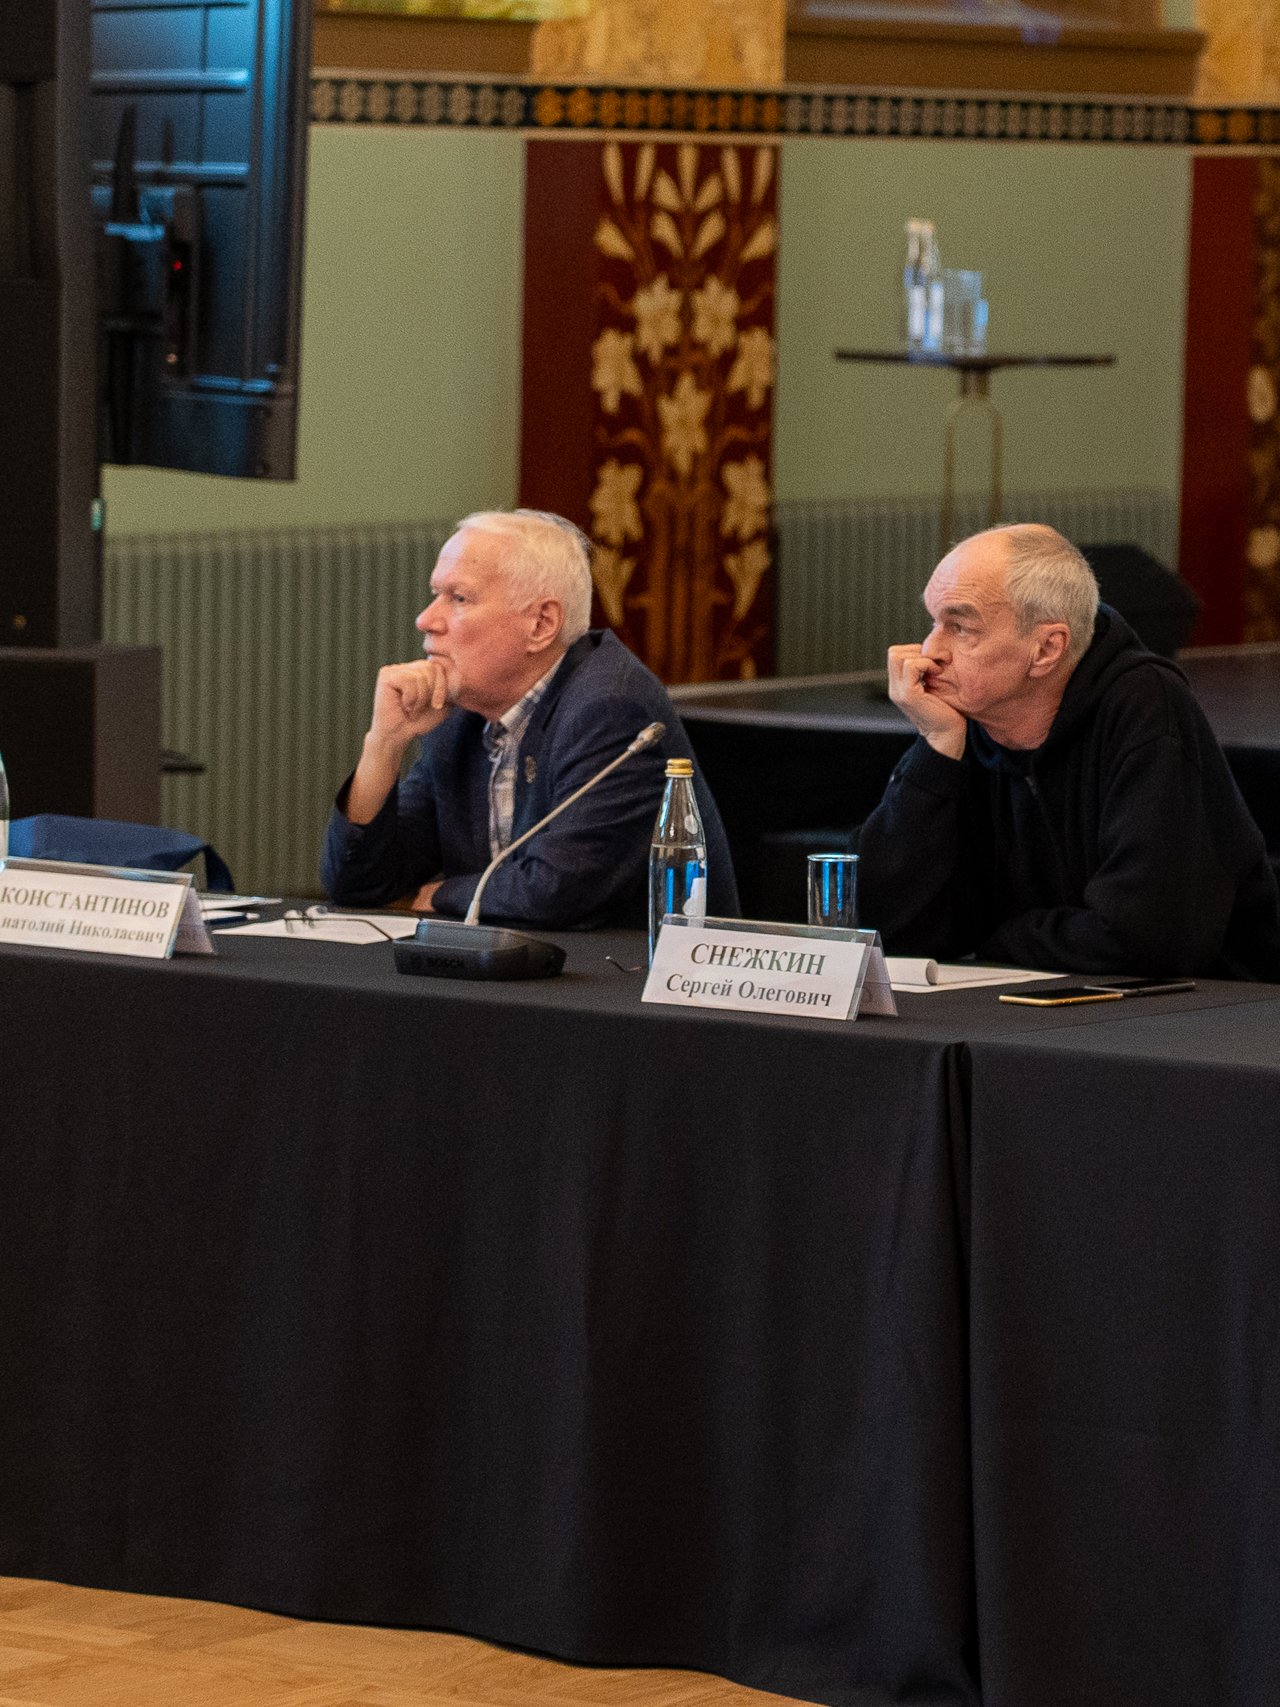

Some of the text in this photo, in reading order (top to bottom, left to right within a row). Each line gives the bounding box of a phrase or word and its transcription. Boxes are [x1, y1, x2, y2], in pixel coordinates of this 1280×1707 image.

[1, 886, 170, 919] КОНСТАНТИНОВ
[0, 917, 165, 944] натолий Николаевич
[426, 956, 465, 968] BOSCH
[690, 942, 827, 976] СНЕЖКИН
[666, 973, 832, 1008] Сергей Олегович
